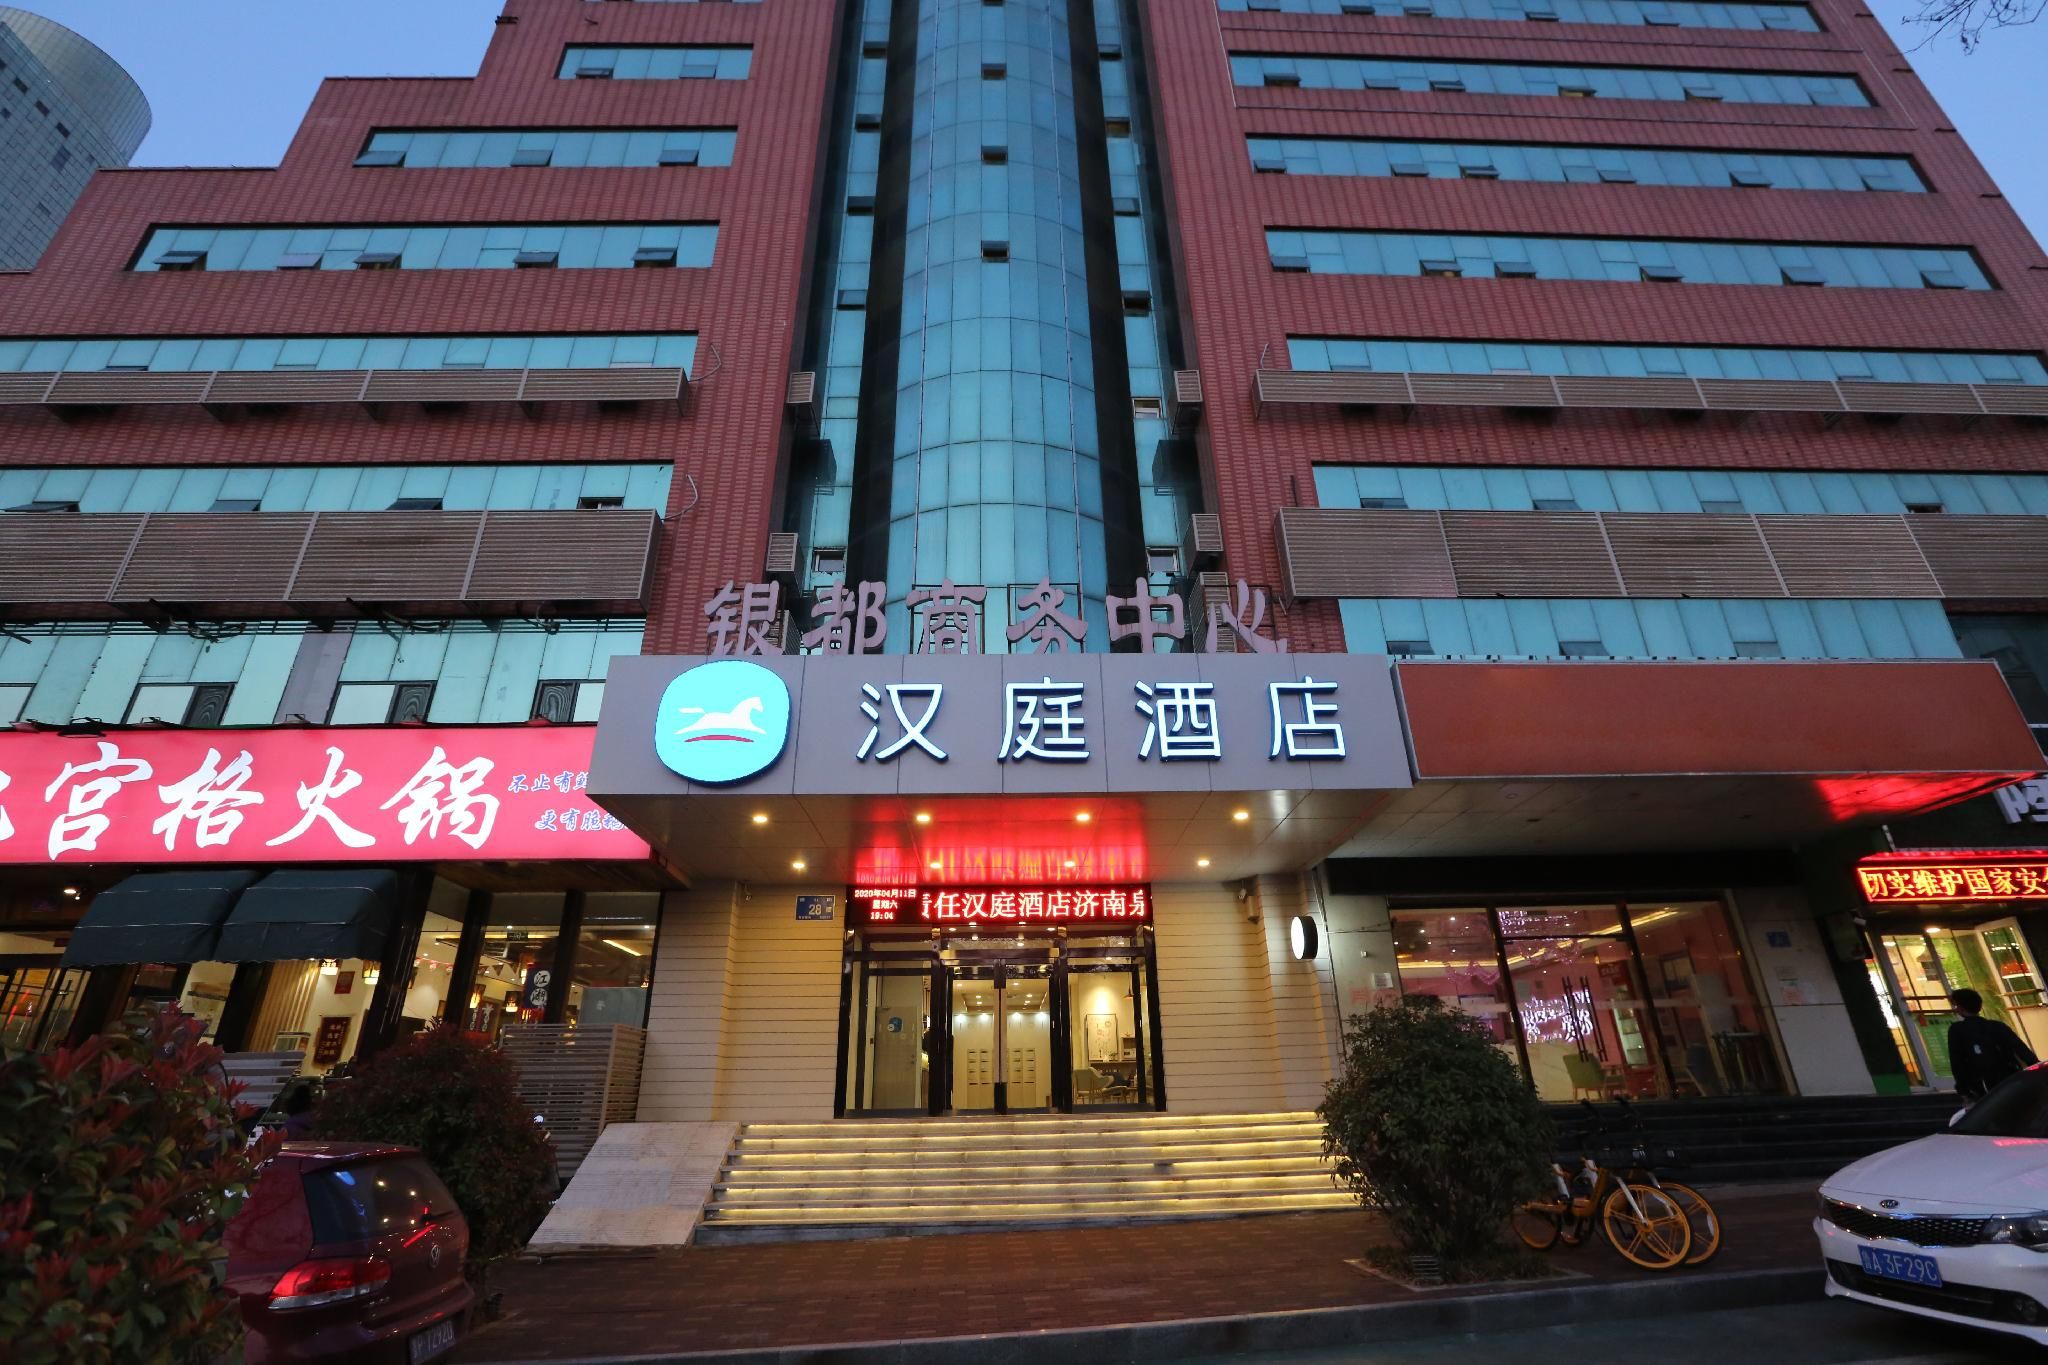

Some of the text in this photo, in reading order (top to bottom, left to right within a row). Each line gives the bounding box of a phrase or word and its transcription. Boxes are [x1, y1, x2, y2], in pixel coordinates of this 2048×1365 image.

[703, 577, 1288, 655] 银都商务中心
[857, 676, 1346, 761] 汉庭酒店
[0, 741, 498, 861] 宫格火锅
[854, 888, 917, 898] 2020年04月11日
[872, 899, 898, 910] 星期六
[1861, 868, 2048, 897] 切实维护国家安
